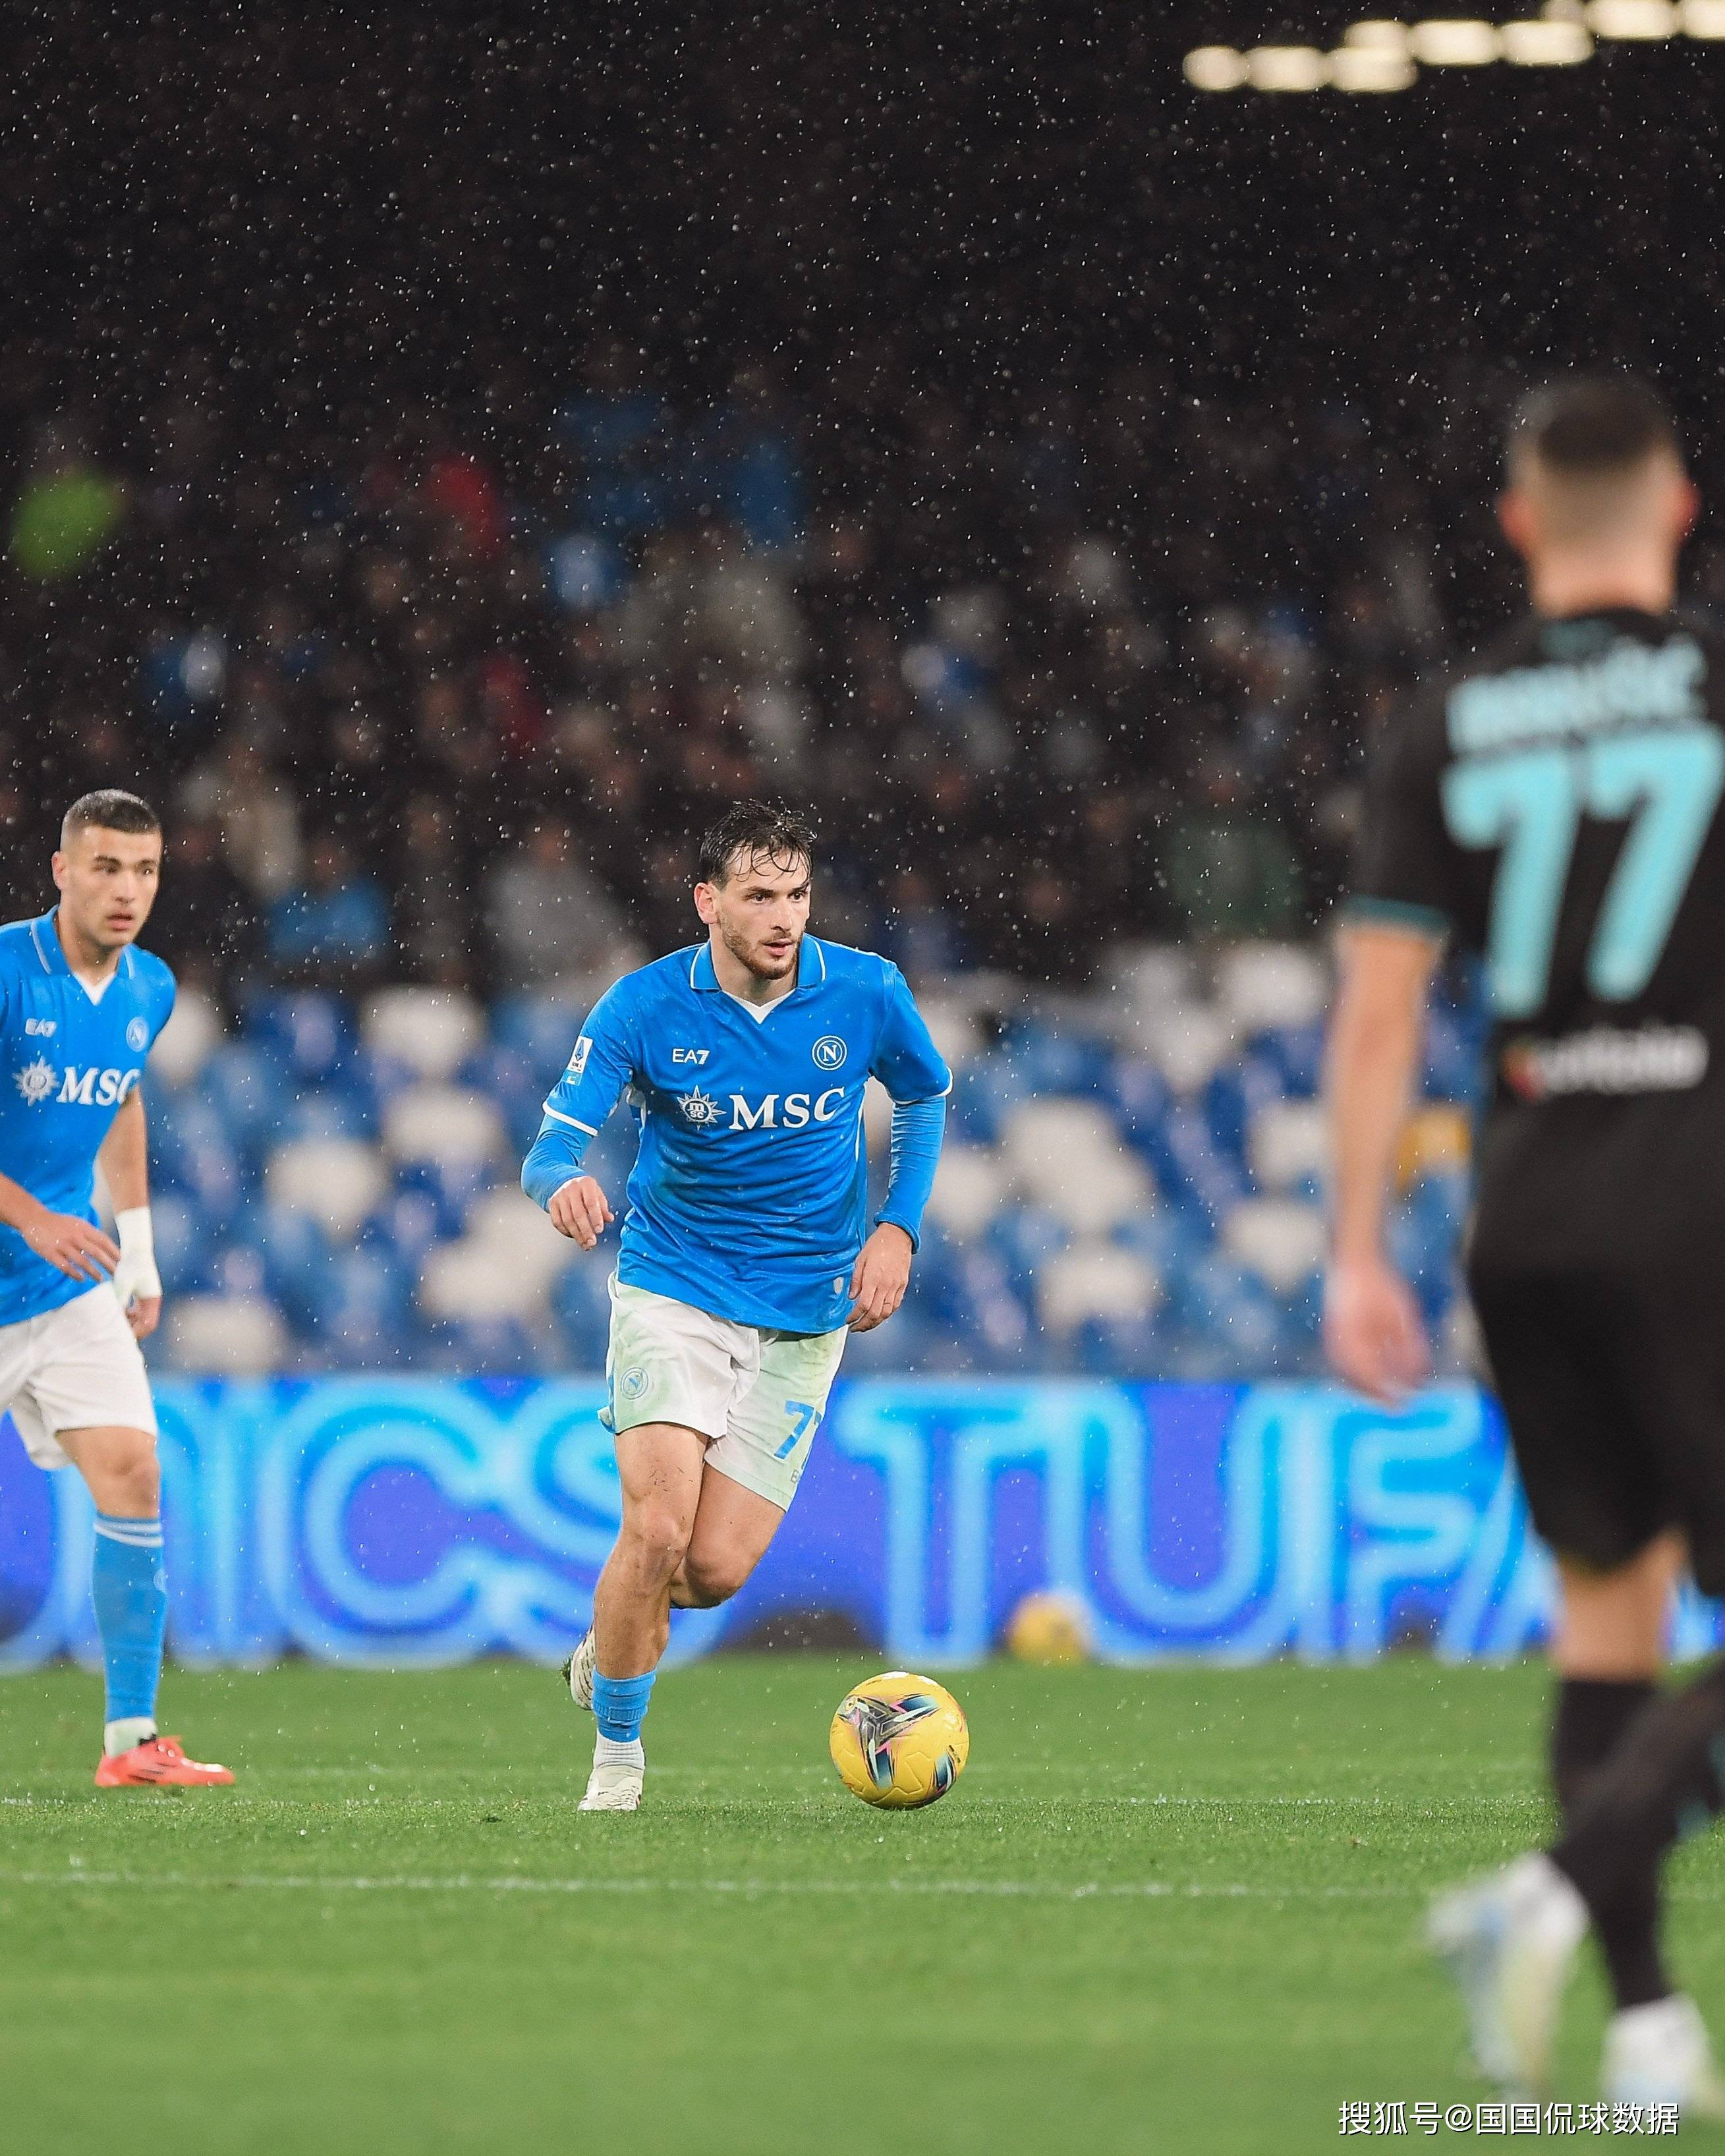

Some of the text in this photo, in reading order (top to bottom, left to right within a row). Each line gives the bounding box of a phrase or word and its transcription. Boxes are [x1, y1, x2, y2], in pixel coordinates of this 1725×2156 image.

[1440, 722, 1725, 1020] 77
[672, 1048, 710, 1065] EA7
[822, 1044, 837, 1062] N
[727, 1086, 845, 1131] MSC
